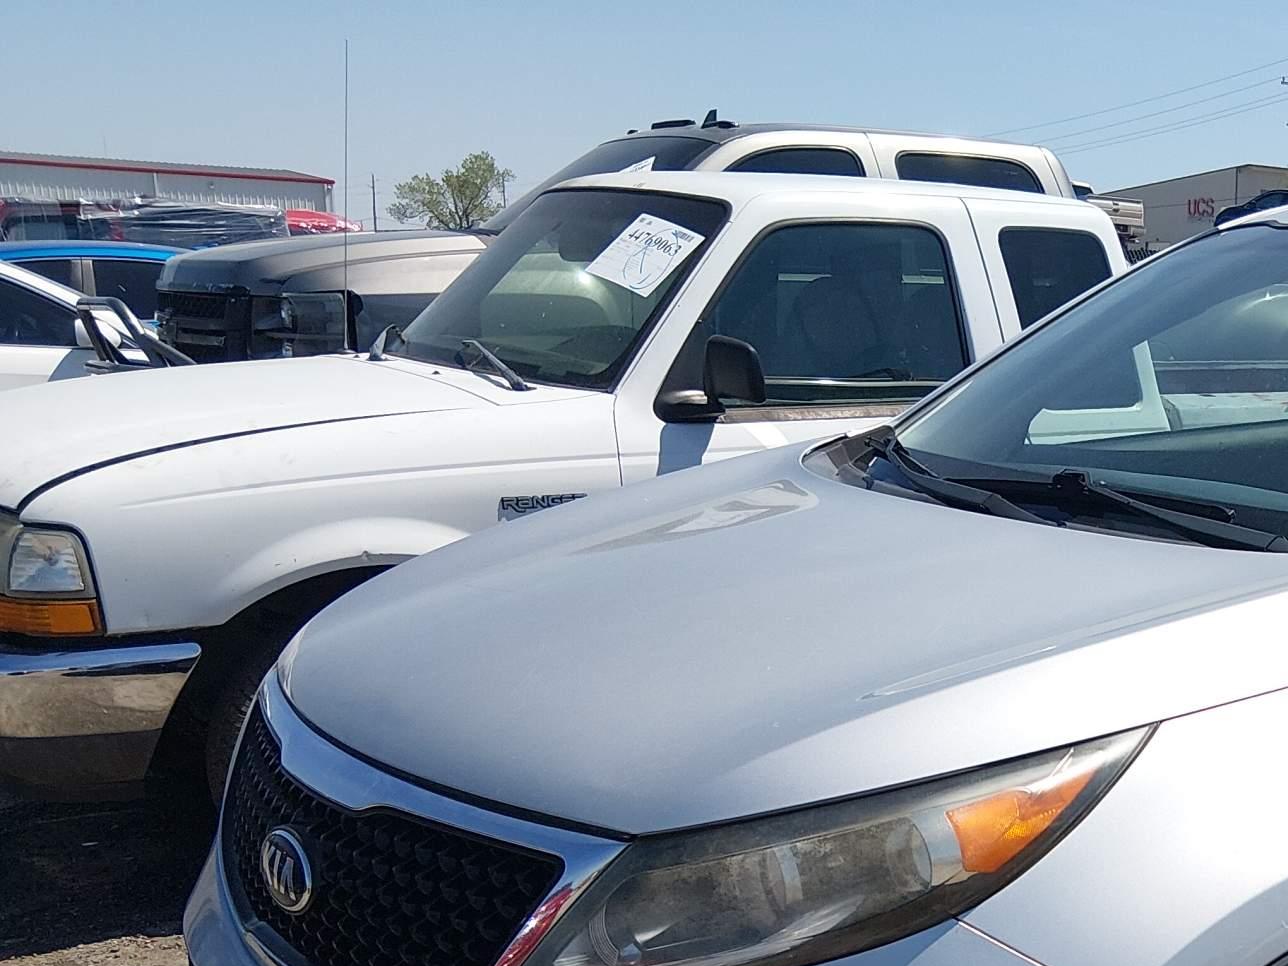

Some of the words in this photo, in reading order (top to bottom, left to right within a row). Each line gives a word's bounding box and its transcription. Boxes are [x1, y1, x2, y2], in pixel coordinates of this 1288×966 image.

[1187, 198, 1215, 217] UCS
[627, 229, 683, 257] 44769063
[262, 839, 297, 902] KIA
